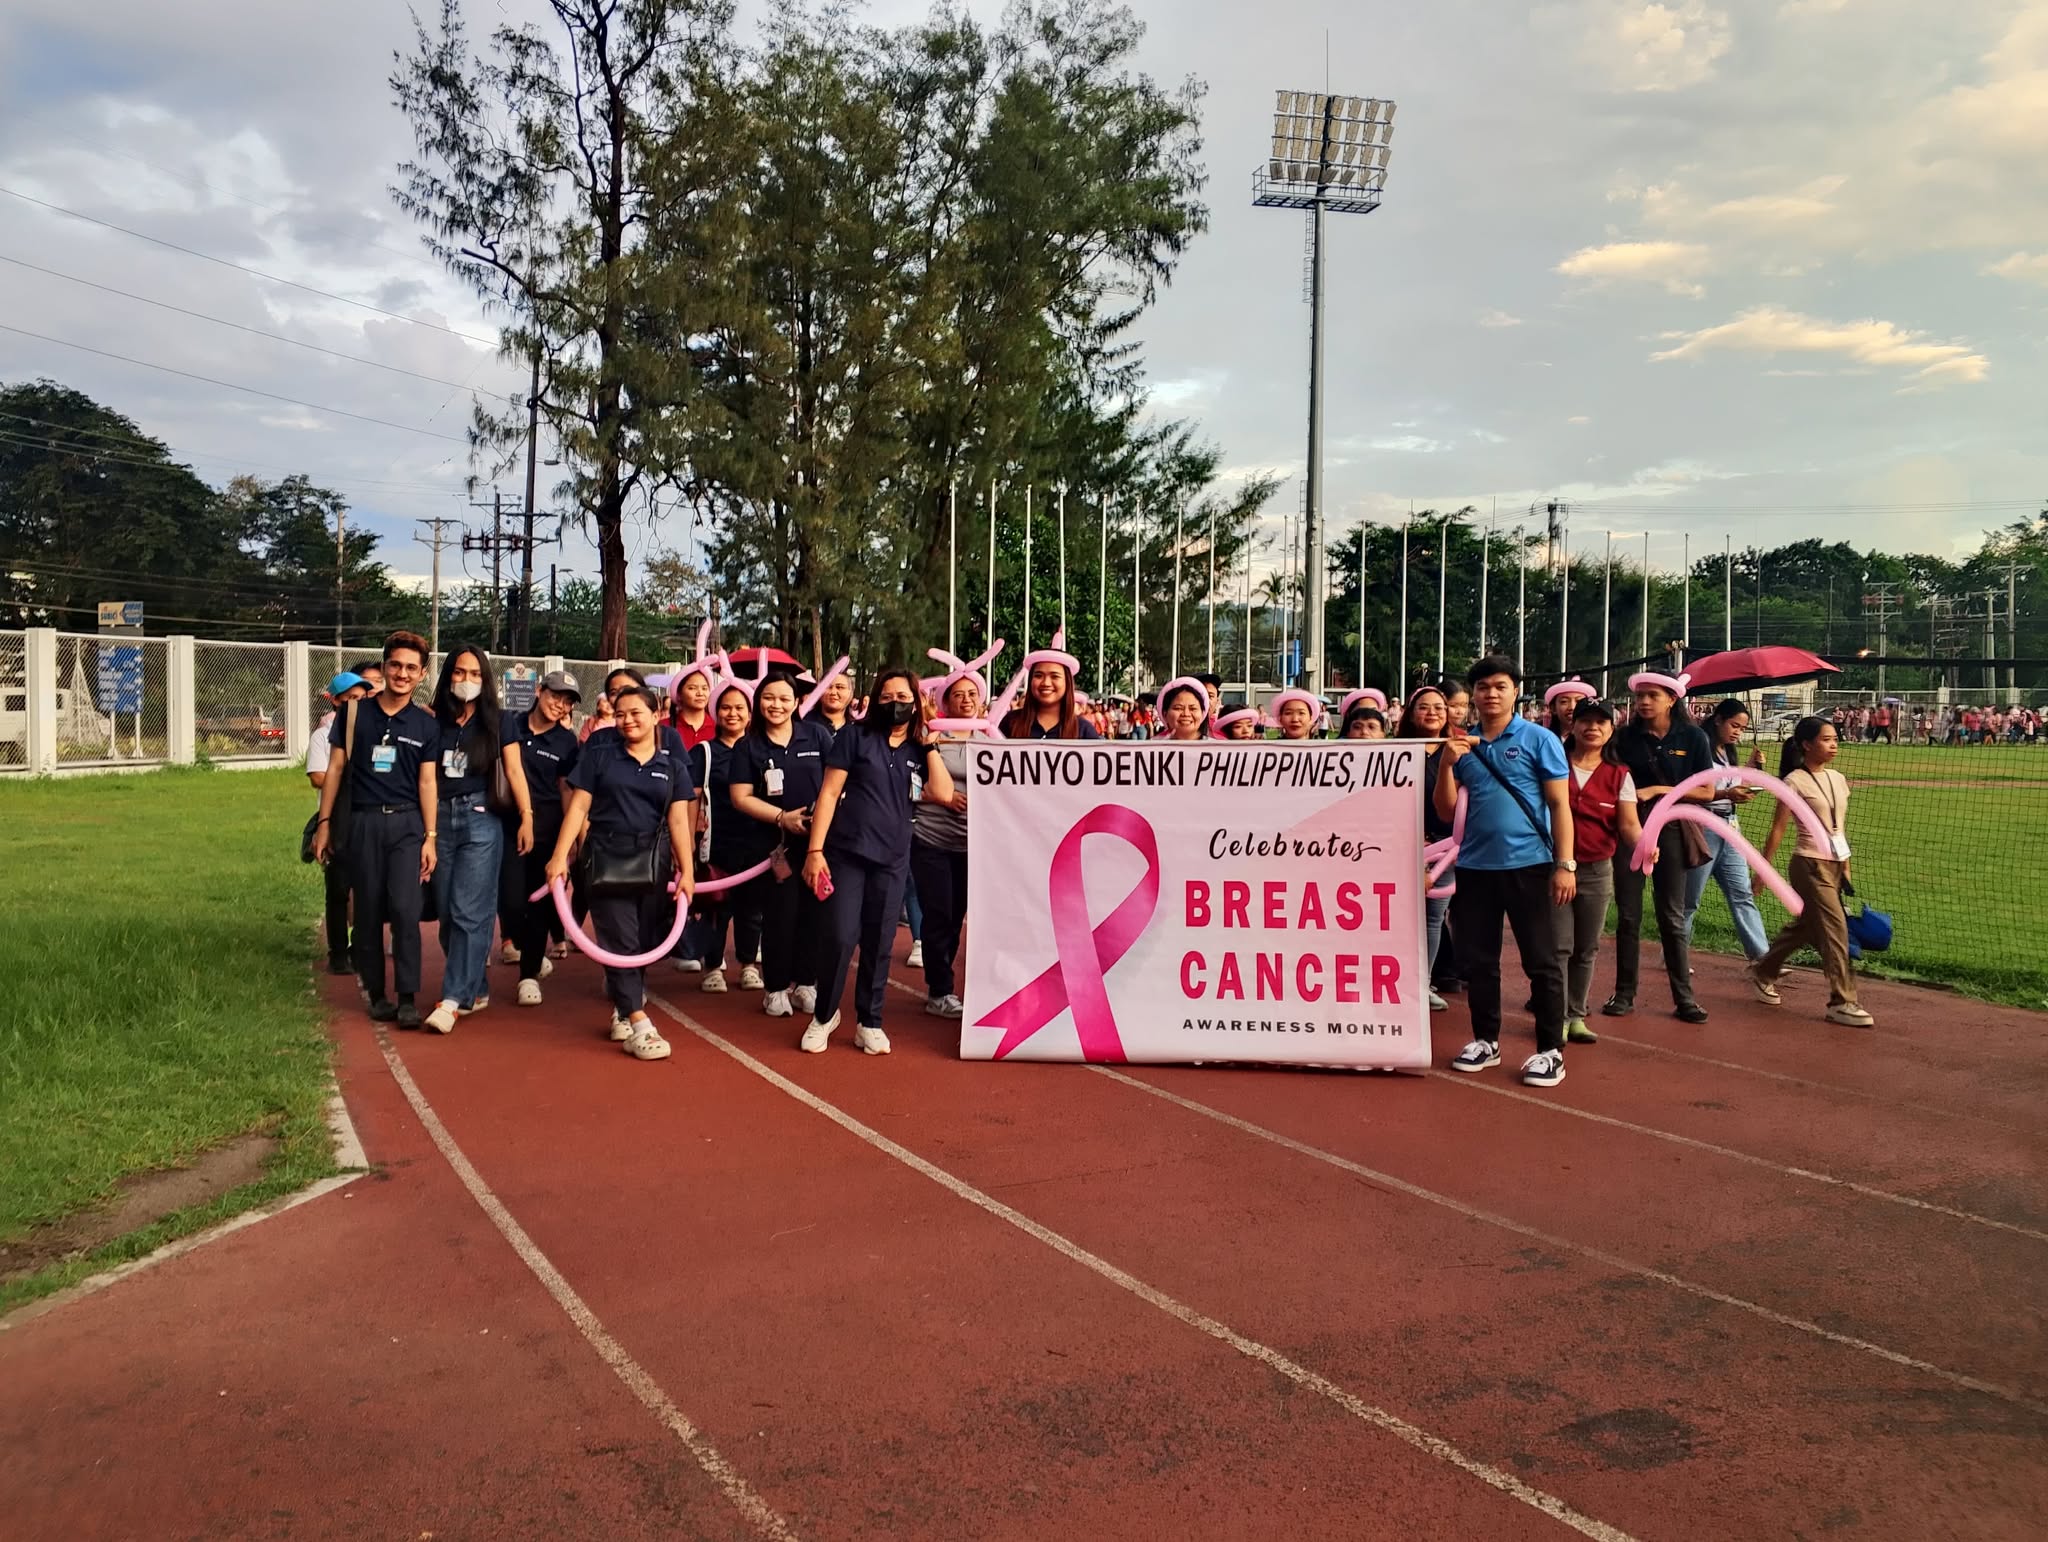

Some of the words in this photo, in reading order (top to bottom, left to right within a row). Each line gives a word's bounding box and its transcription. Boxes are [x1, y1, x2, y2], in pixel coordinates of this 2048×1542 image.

[976, 750, 1084, 787] SANYO
[1093, 750, 1185, 787] DENKI
[1194, 751, 1356, 793] PHILIPPINES,
[1362, 751, 1415, 788] INC.
[1209, 828, 1382, 862] Celebrates
[1185, 880, 1396, 932] BREAST
[1180, 951, 1401, 1005] CANCER
[1182, 1019, 1316, 1035] AWARENESS
[1328, 1023, 1404, 1037] MONTH
